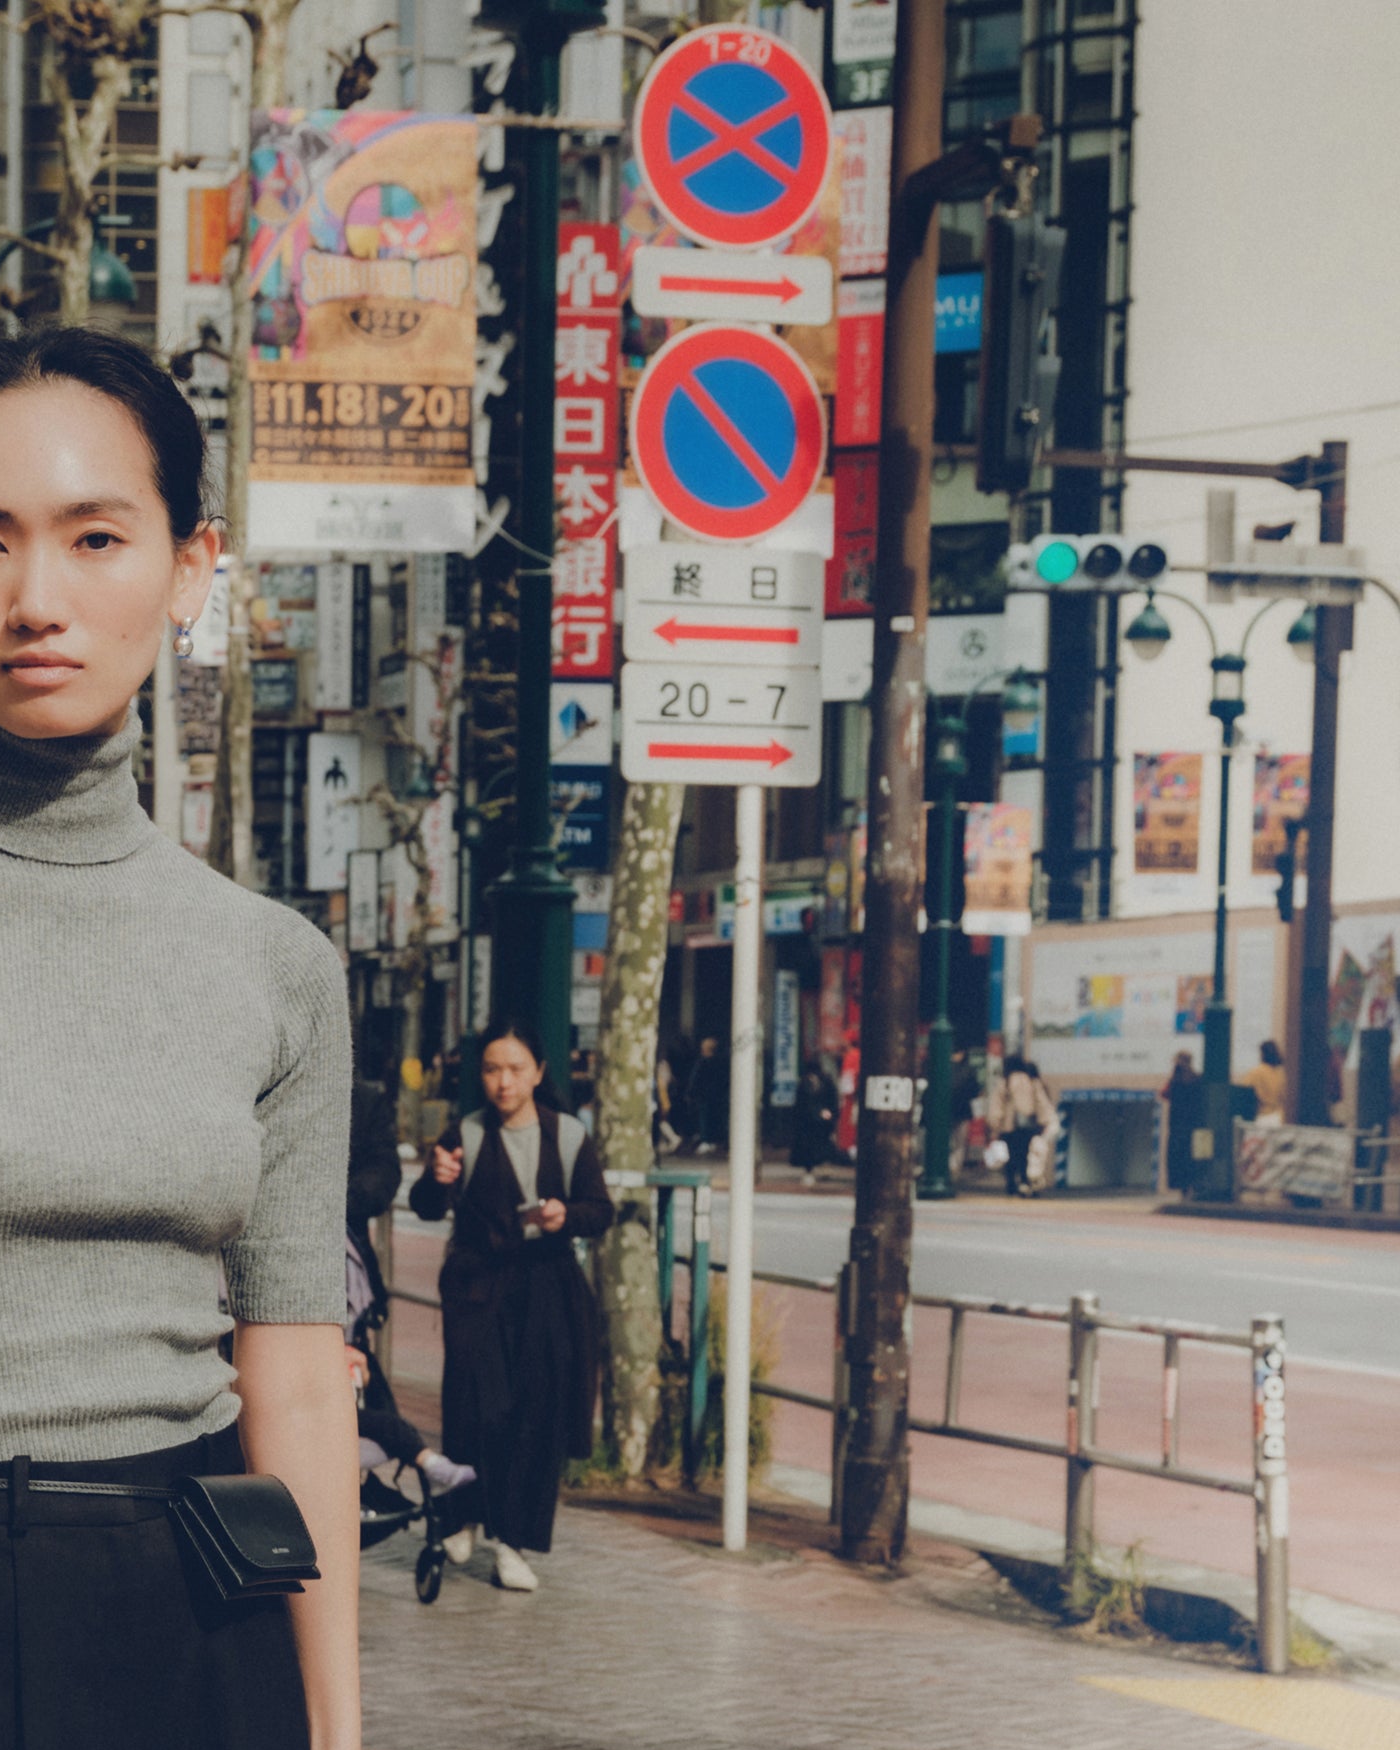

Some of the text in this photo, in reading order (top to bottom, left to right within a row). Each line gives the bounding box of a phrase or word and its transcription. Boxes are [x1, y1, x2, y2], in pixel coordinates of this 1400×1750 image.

[850, 68, 890, 101] 3F
[270, 382, 365, 426] 11.18
[399, 384, 456, 428] 20
[552, 323, 611, 668] 東日本銀行
